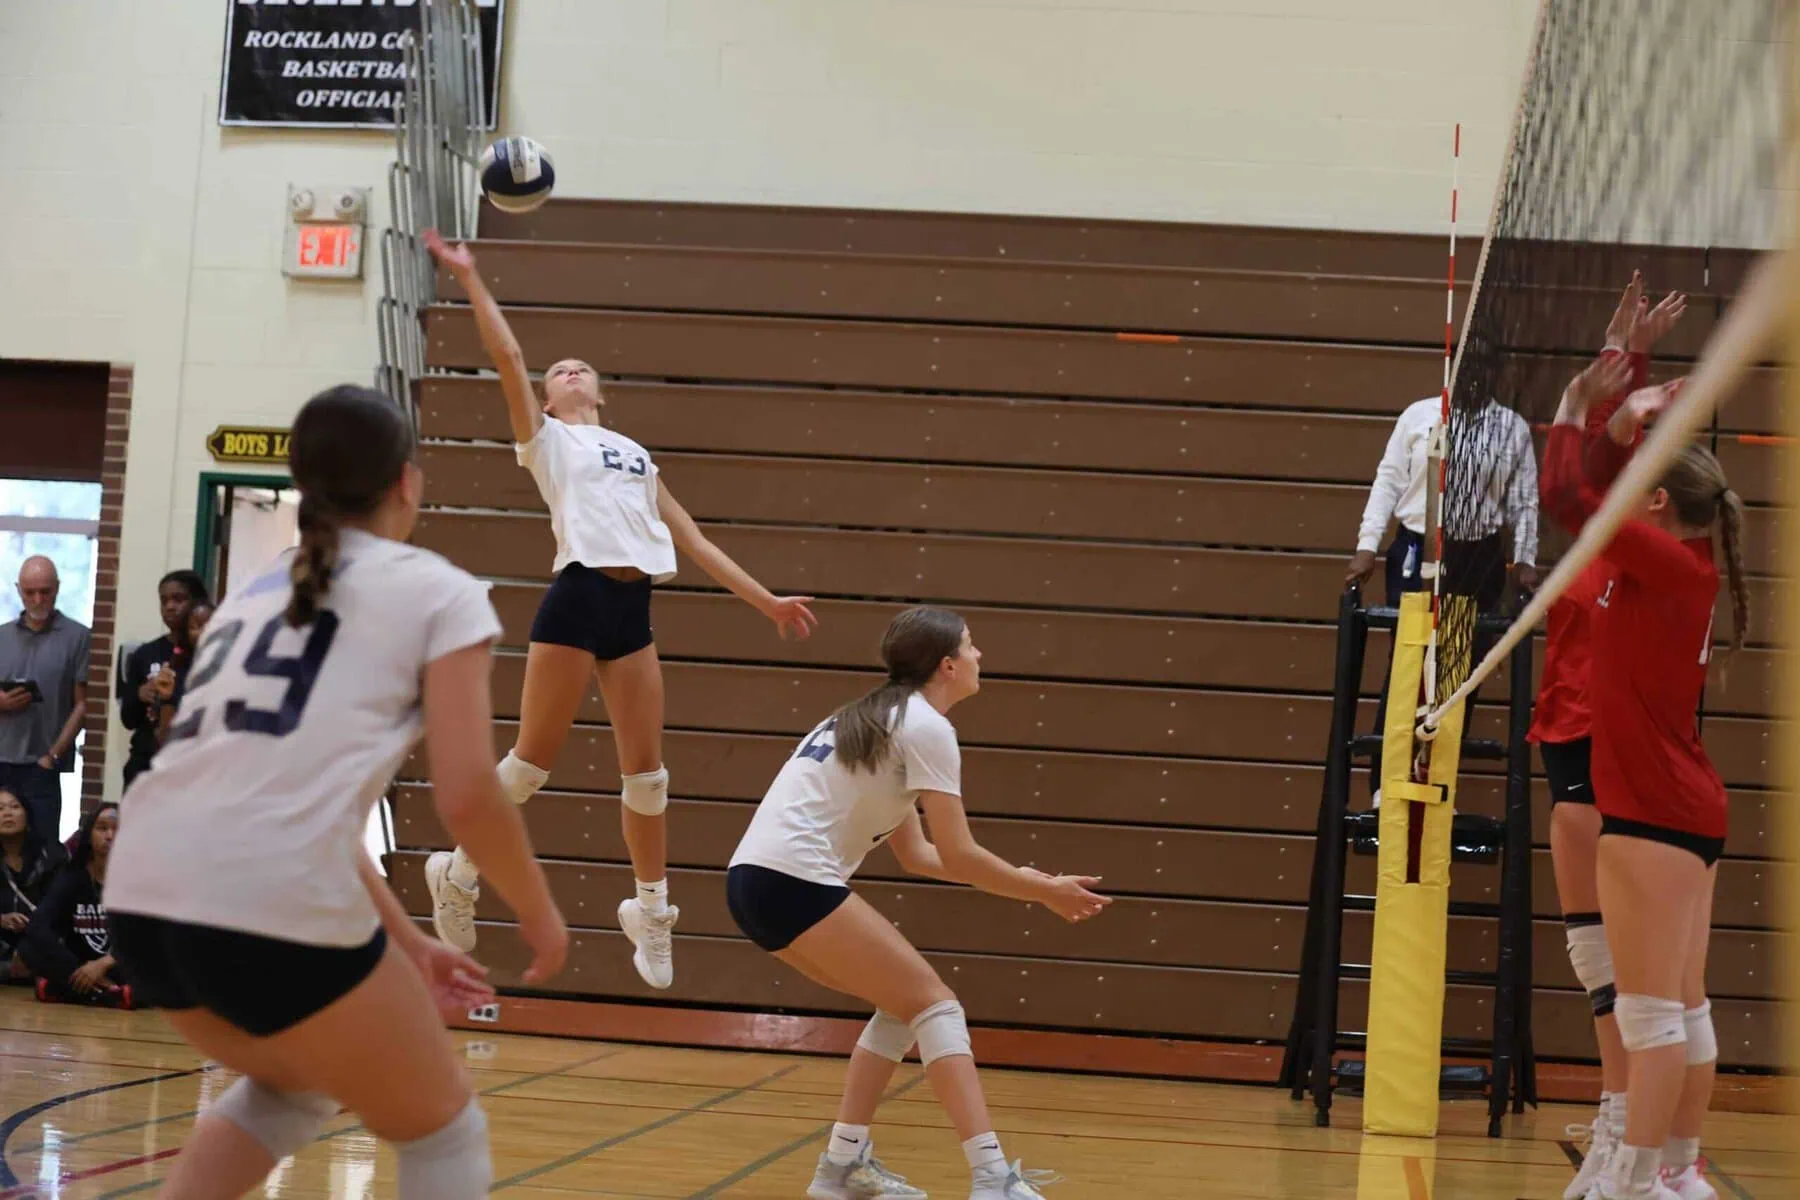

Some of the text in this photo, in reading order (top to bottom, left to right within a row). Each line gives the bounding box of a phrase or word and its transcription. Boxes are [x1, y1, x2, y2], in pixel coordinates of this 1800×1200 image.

[244, 31, 377, 49] ROCKLAND
[282, 60, 417, 79] BASKETBA
[296, 90, 406, 109] OFFICIAL
[223, 432, 268, 457] BOYS
[167, 608, 341, 738] 29
